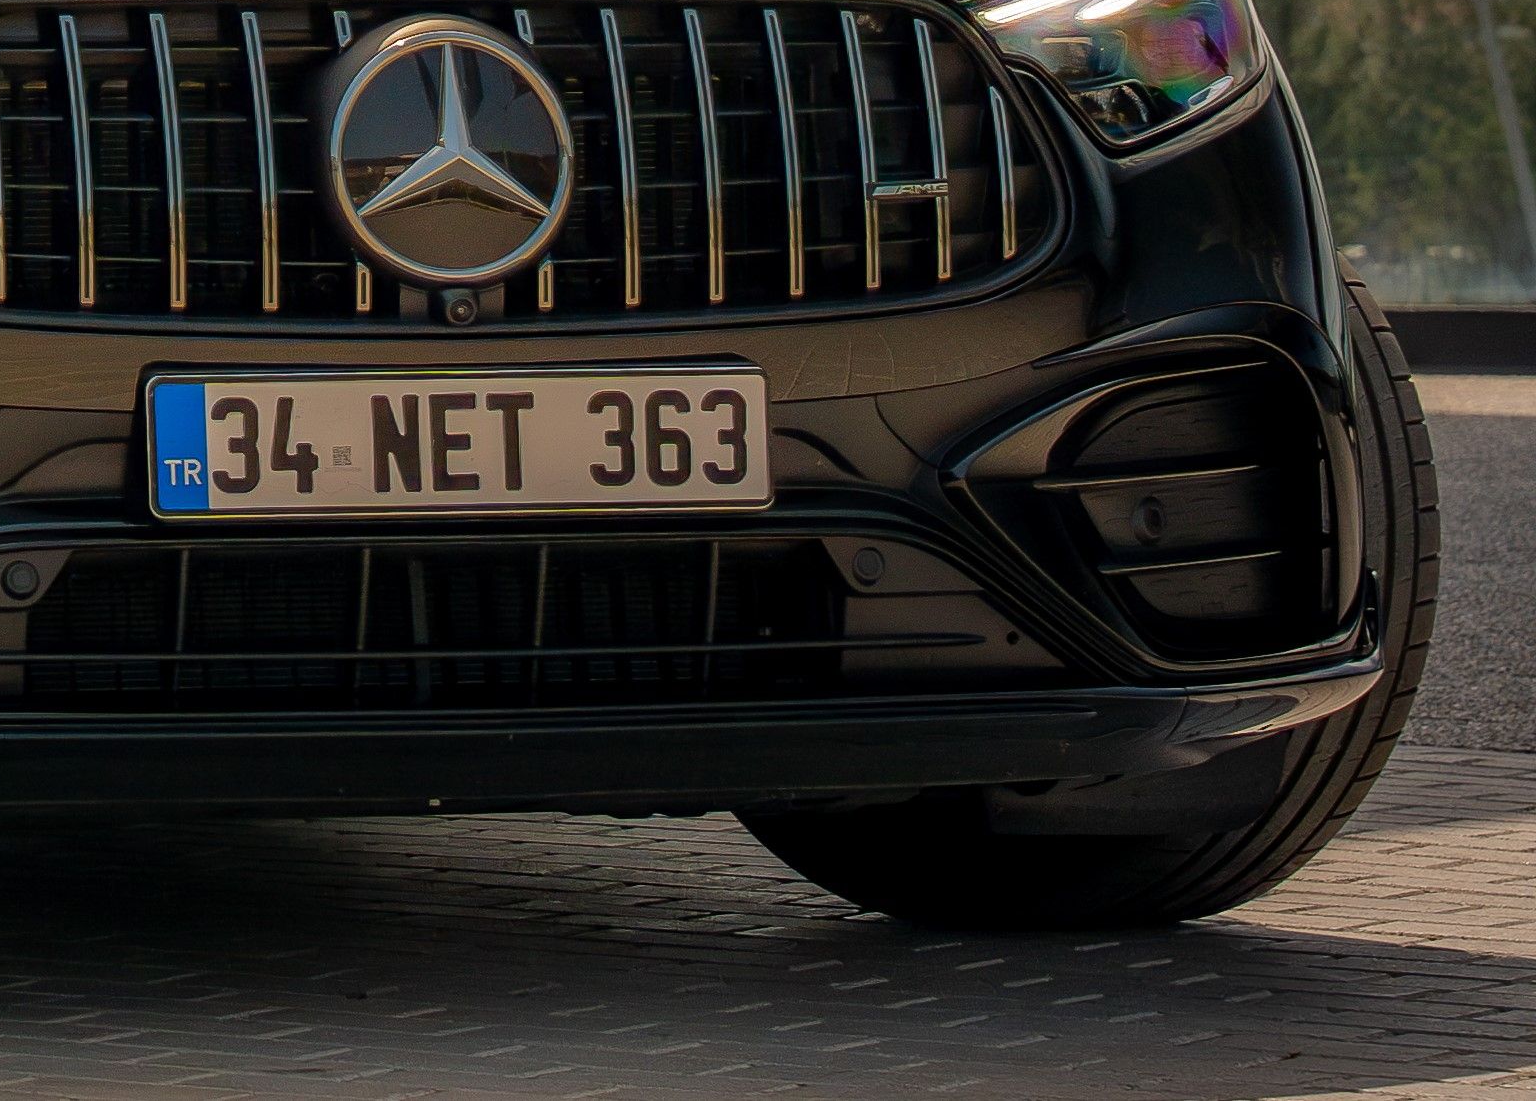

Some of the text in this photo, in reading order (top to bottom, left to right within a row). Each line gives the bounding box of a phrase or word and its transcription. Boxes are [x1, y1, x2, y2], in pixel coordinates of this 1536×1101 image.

[164, 458, 203, 487] TR
[210, 389, 748, 495] 34 NET 363
